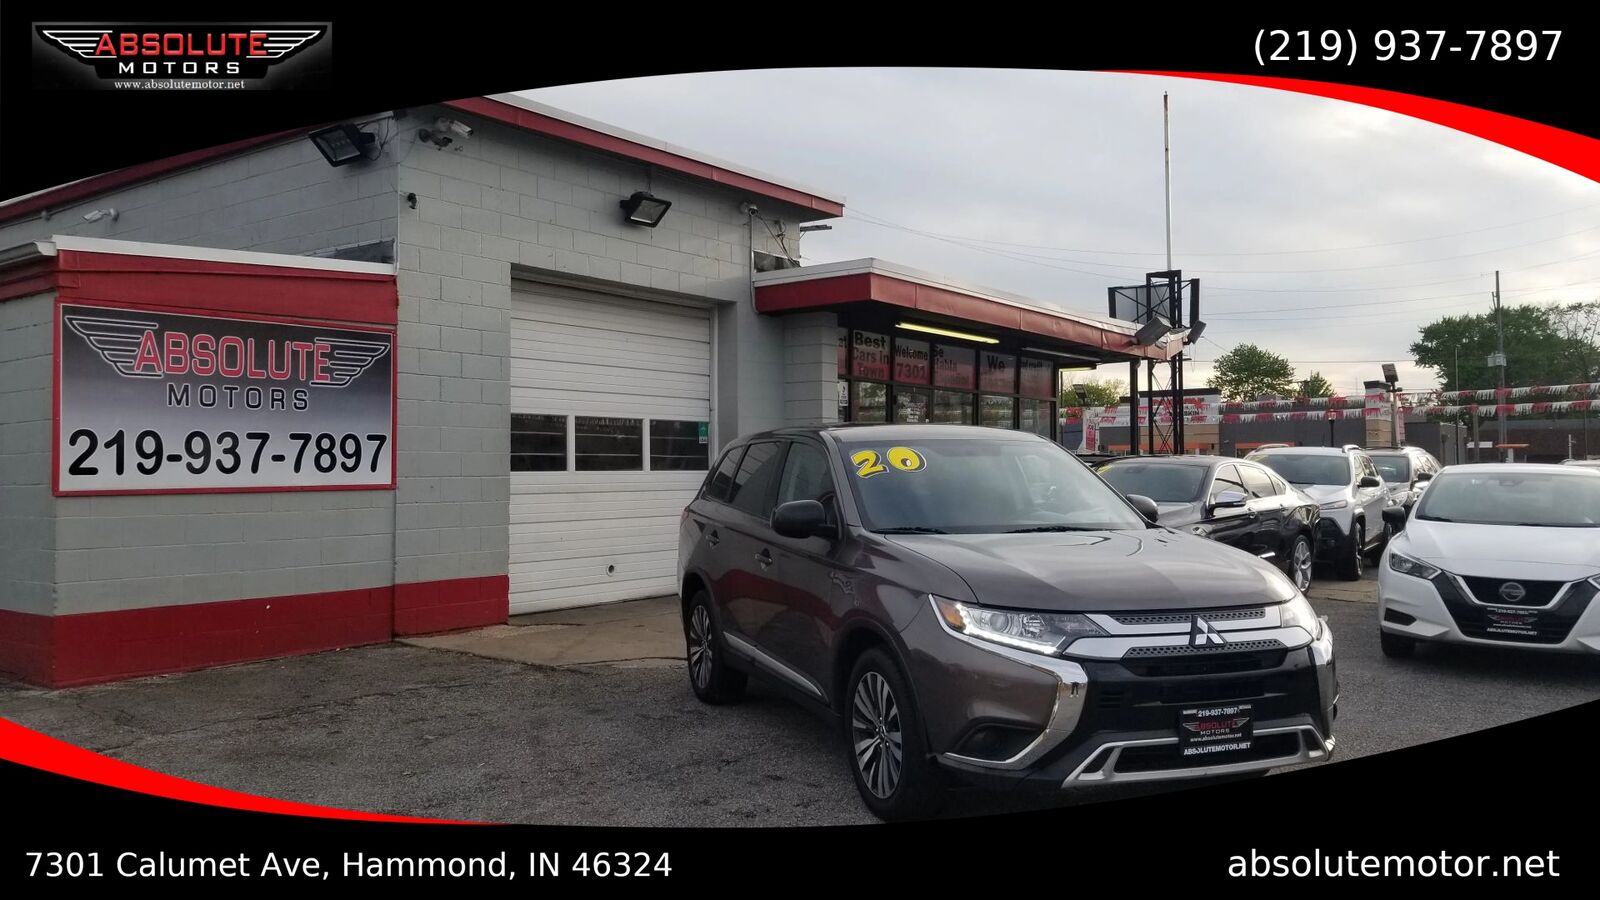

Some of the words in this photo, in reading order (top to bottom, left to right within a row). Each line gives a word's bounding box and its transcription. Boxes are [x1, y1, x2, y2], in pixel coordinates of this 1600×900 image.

[854, 331, 887, 350] Best
[134, 330, 331, 382] ABSOLUTE
[853, 347, 877, 363] Cars
[895, 344, 929, 361] Welcome
[857, 363, 886, 378] Town
[896, 363, 927, 380] 7301
[987, 355, 1006, 370] We
[167, 383, 310, 411] MOTORS
[68, 428, 388, 476] 219-937-7897
[850, 446, 927, 479] 20
